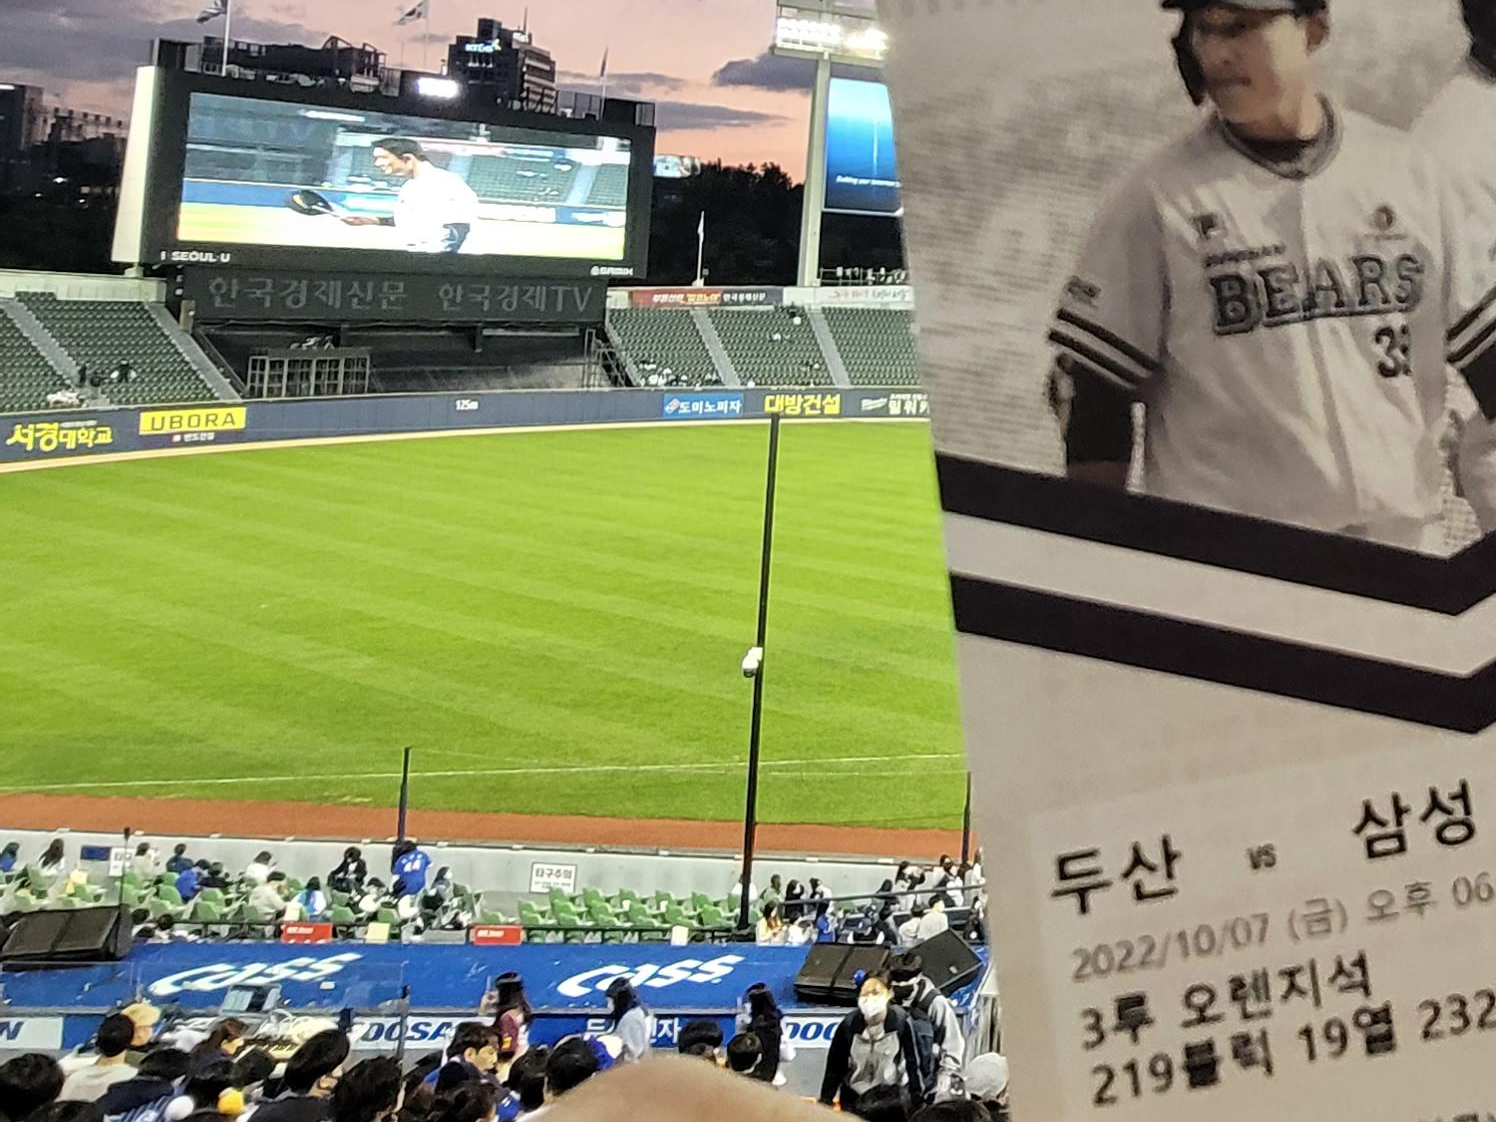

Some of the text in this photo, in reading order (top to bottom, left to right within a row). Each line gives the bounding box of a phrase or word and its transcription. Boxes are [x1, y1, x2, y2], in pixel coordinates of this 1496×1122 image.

[209, 278, 593, 312] 한국경제신문 한국경제TV
[1210, 254, 1425, 336] BEARS
[456, 399, 479, 411] 125m
[678, 400, 742, 414] 도미노피자
[763, 394, 842, 416] 대방건설
[6, 422, 113, 452] 서경대학교
[151, 413, 237, 431] UBORA
[1051, 833, 1182, 915] 두산
[1352, 779, 1477, 860] 삼성
[535, 868, 573, 880] 타구주의
[1071, 912, 1270, 982] 2022/10/07
[1287, 898, 1349, 943] (금)
[1364, 881, 1438, 925] 오후
[1080, 948, 1374, 1050] 3루 오렌지석
[1299, 1000, 1399, 1064] 19열
